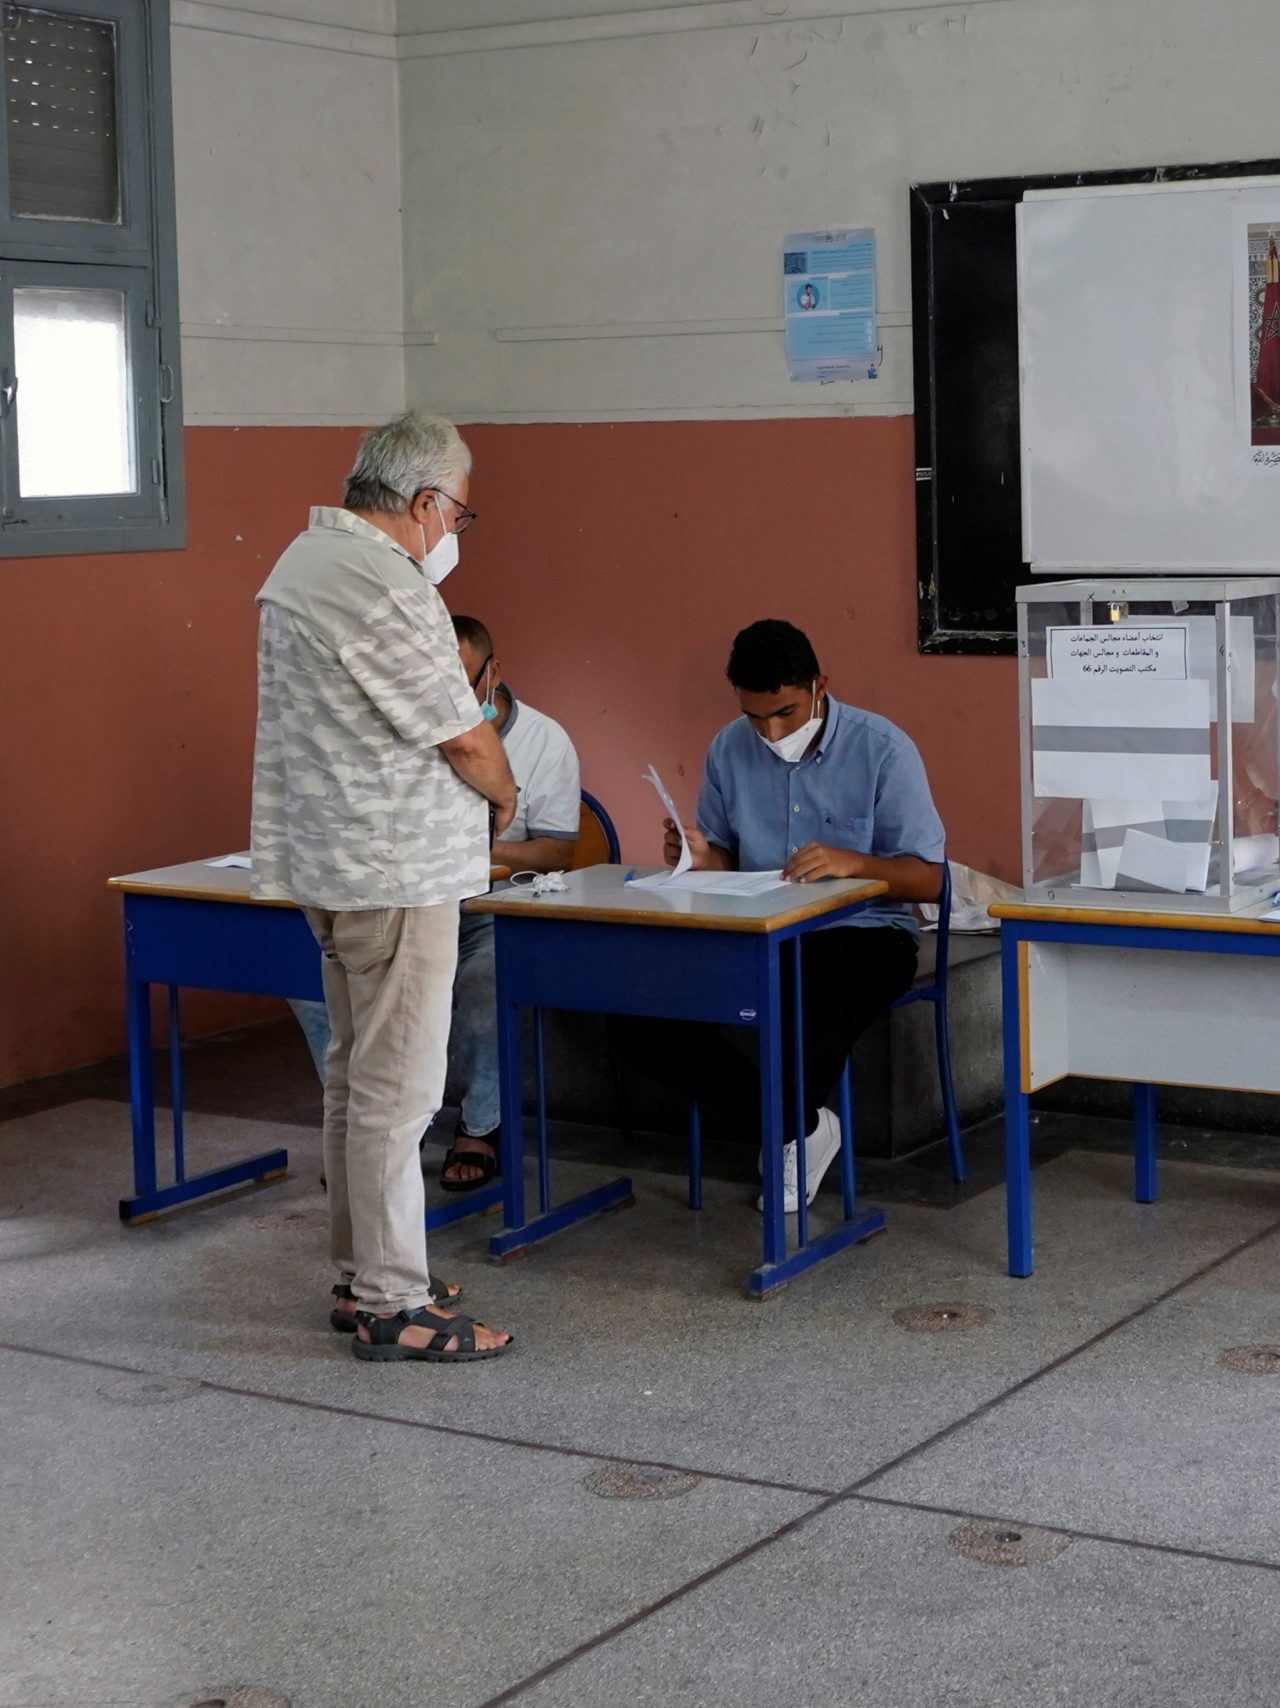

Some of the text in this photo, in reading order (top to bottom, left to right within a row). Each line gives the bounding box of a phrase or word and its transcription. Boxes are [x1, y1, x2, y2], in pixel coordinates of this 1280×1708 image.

[1071, 634, 1098, 642] الجماعات
[1100, 634, 1120, 643] مجالس
[1123, 632, 1140, 641] أعضاء
[1071, 649, 1091, 657] الجهات
[1094, 649, 1114, 658] مجالس
[1093, 665, 1107, 674] الرقم
[1109, 665, 1135, 673] التصويت
